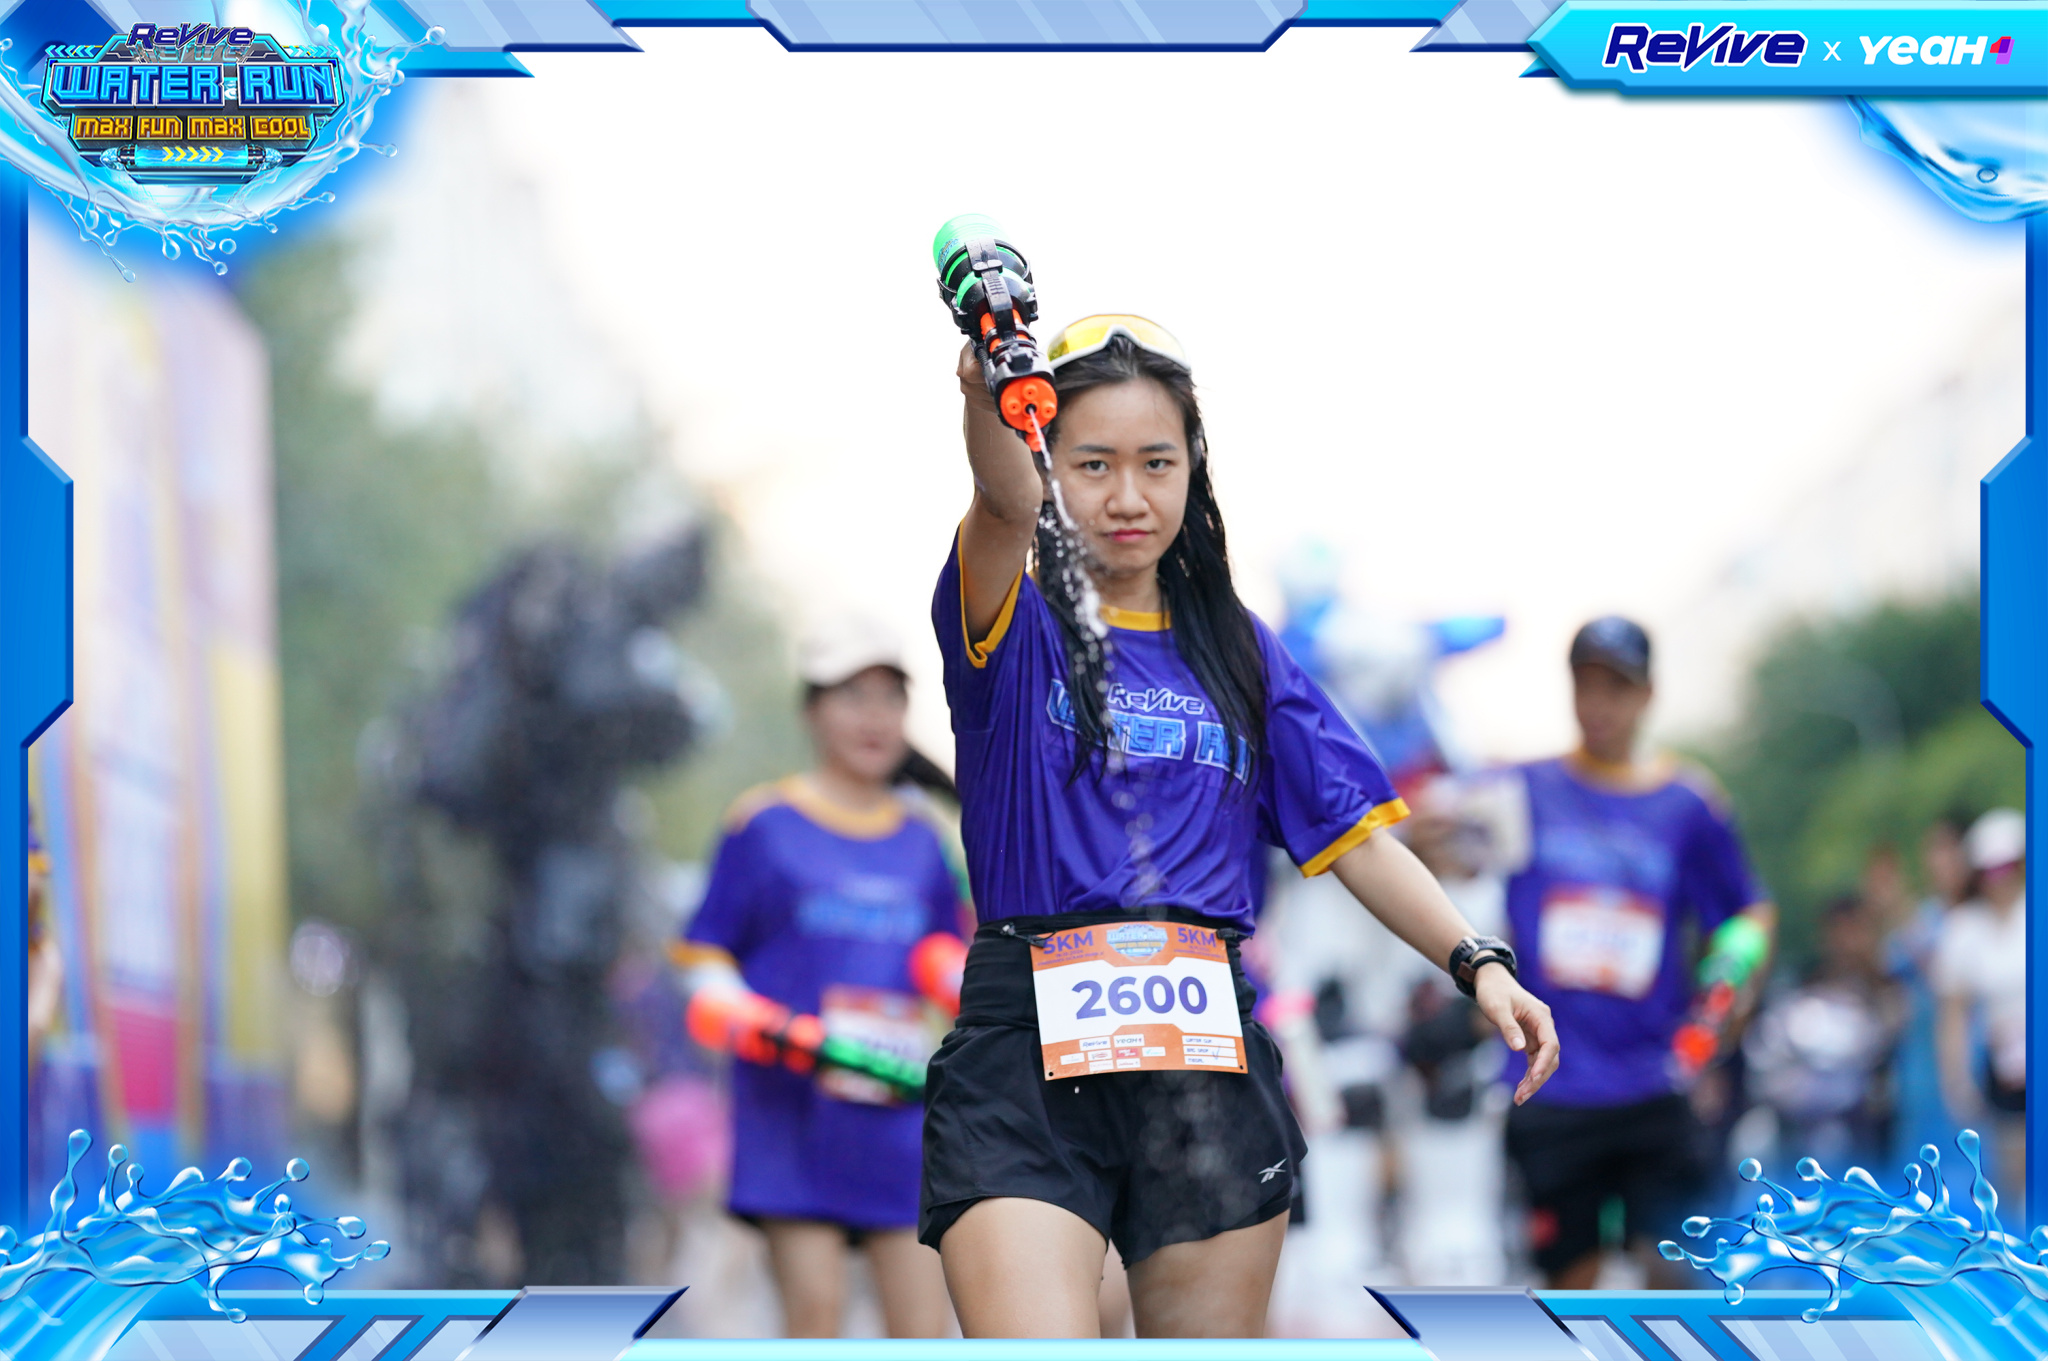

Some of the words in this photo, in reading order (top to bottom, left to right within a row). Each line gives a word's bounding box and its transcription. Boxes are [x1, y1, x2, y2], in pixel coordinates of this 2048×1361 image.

[1046, 678, 1187, 760] WTER
[1043, 930, 1094, 955] 5KM
[1177, 927, 1216, 948] 5KM
[1071, 975, 1208, 1020] 2600
